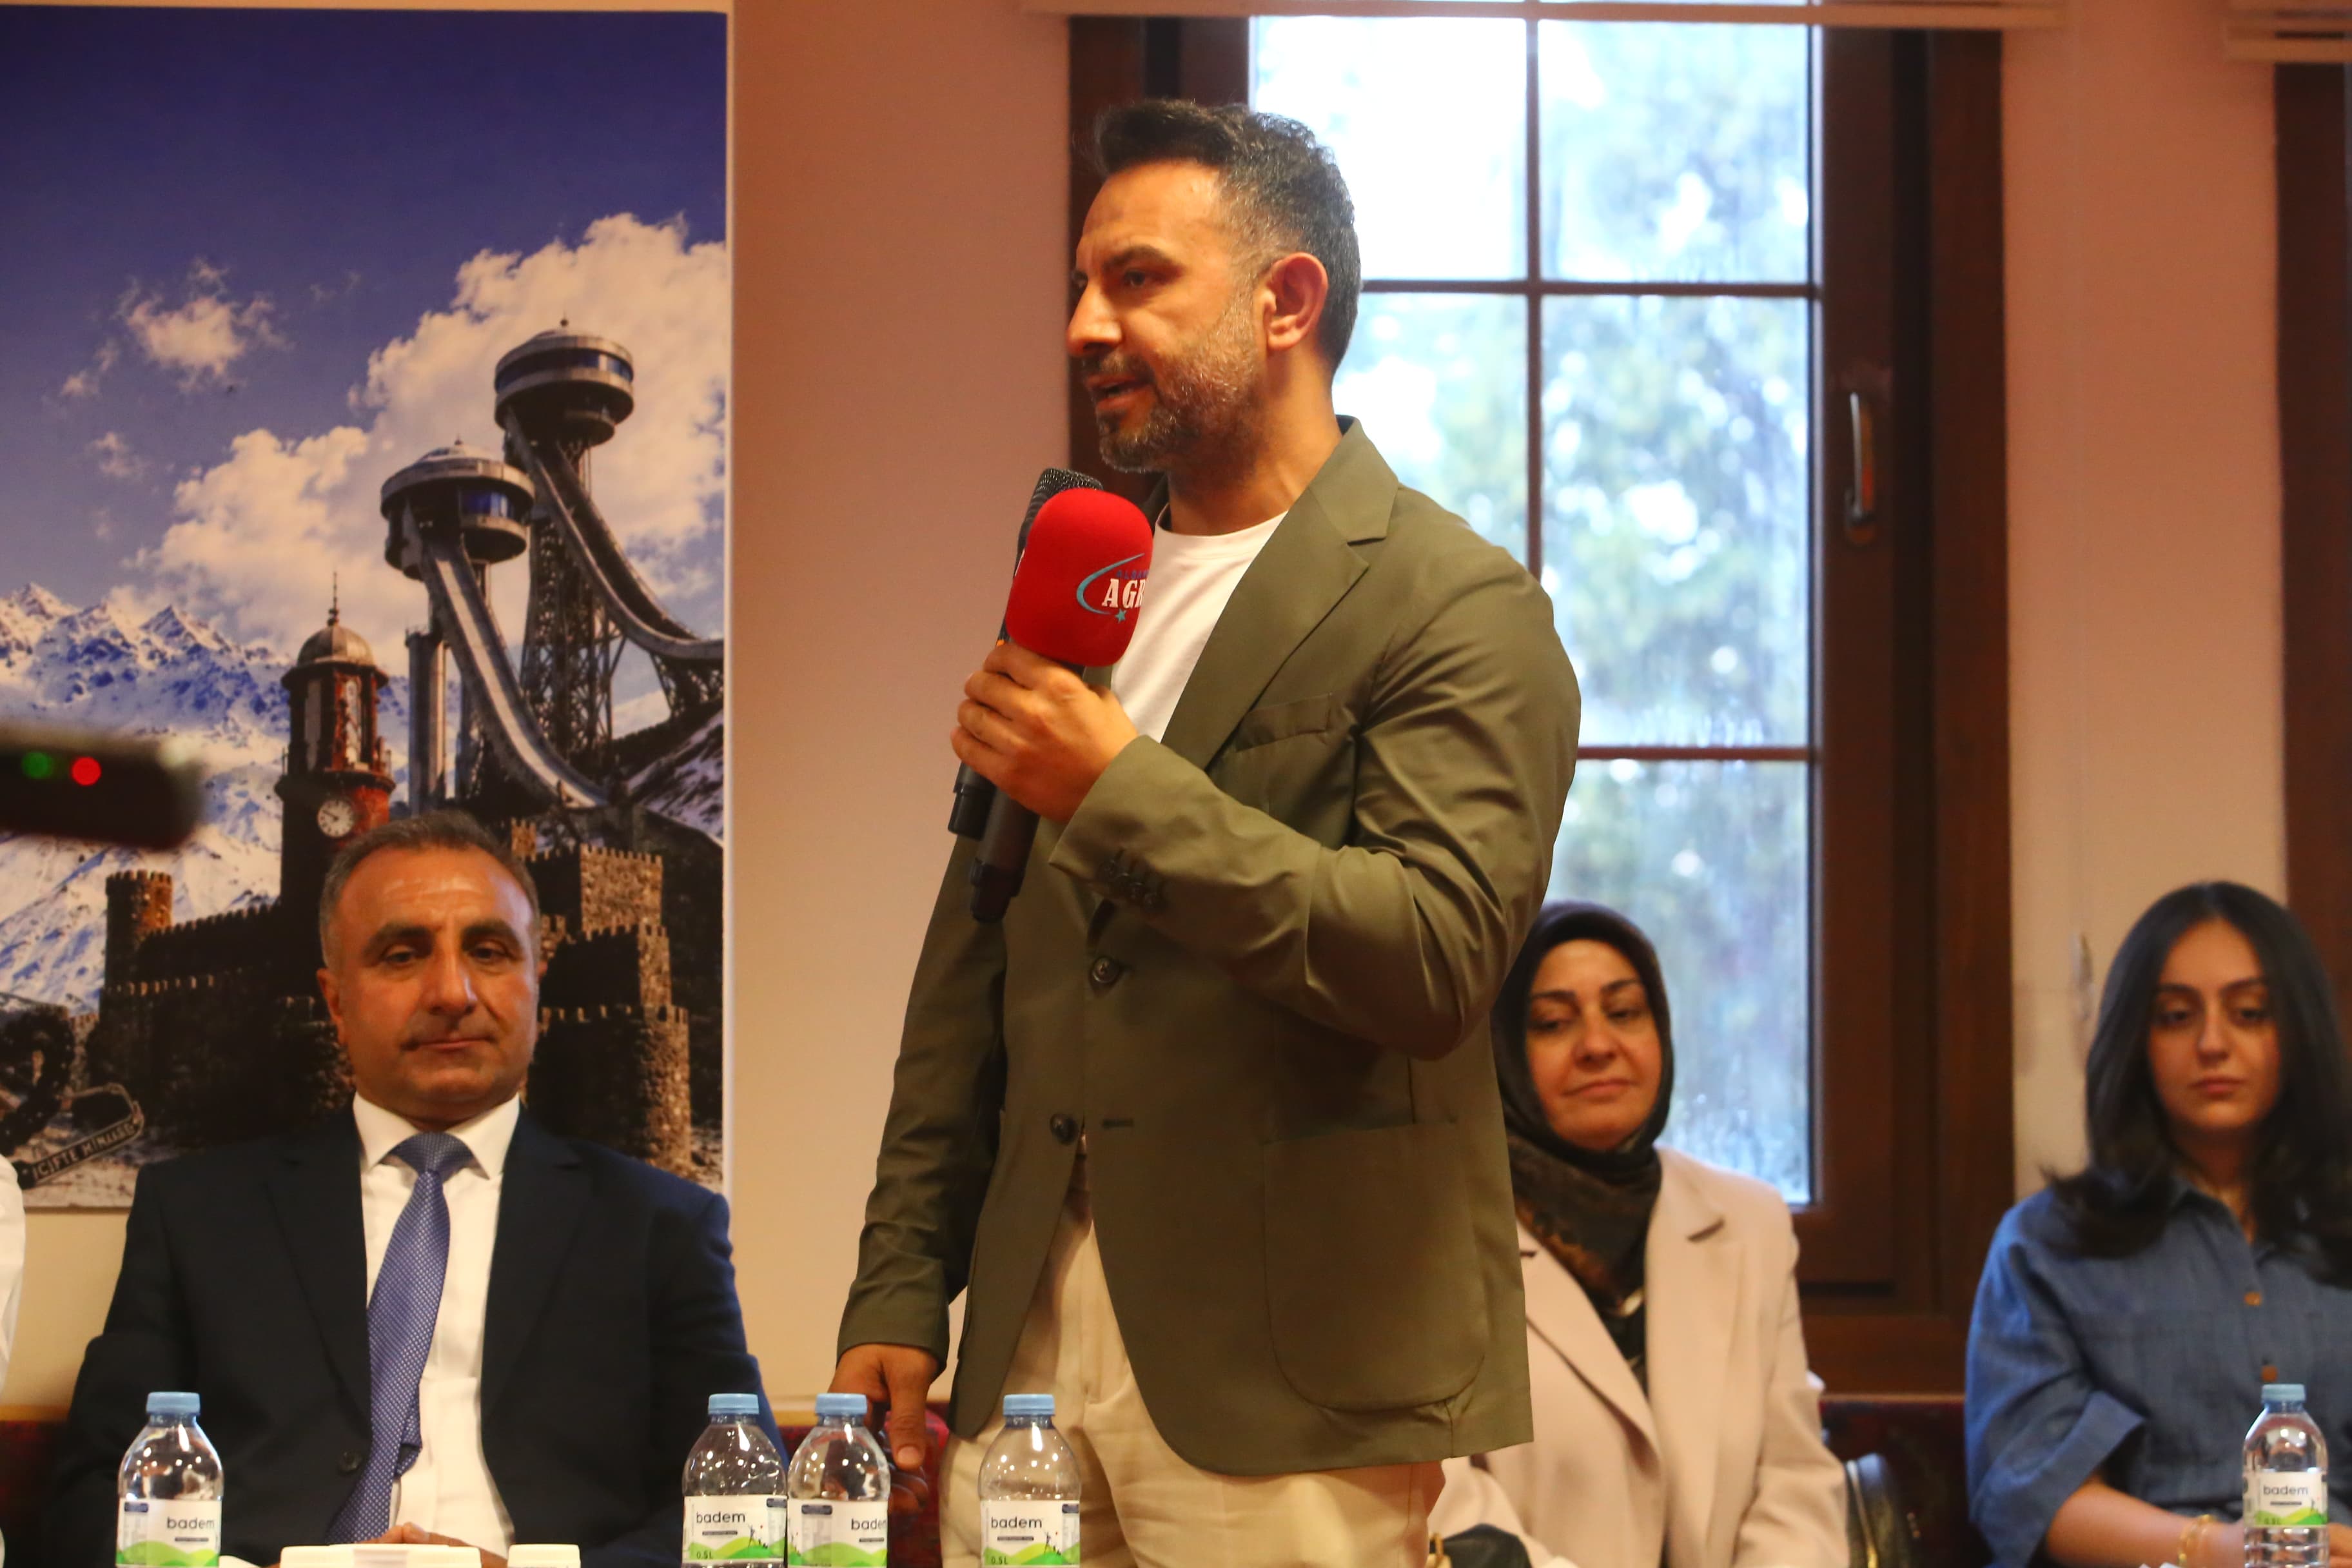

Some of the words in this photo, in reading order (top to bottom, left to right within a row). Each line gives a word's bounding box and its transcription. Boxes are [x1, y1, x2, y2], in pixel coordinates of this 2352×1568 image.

[1101, 578, 1148, 609] AGR
[2263, 1485, 2309, 1495] badem
[166, 1516, 215, 1530] badem
[696, 1511, 746, 1524] badem
[990, 1516, 1043, 1529] badem
